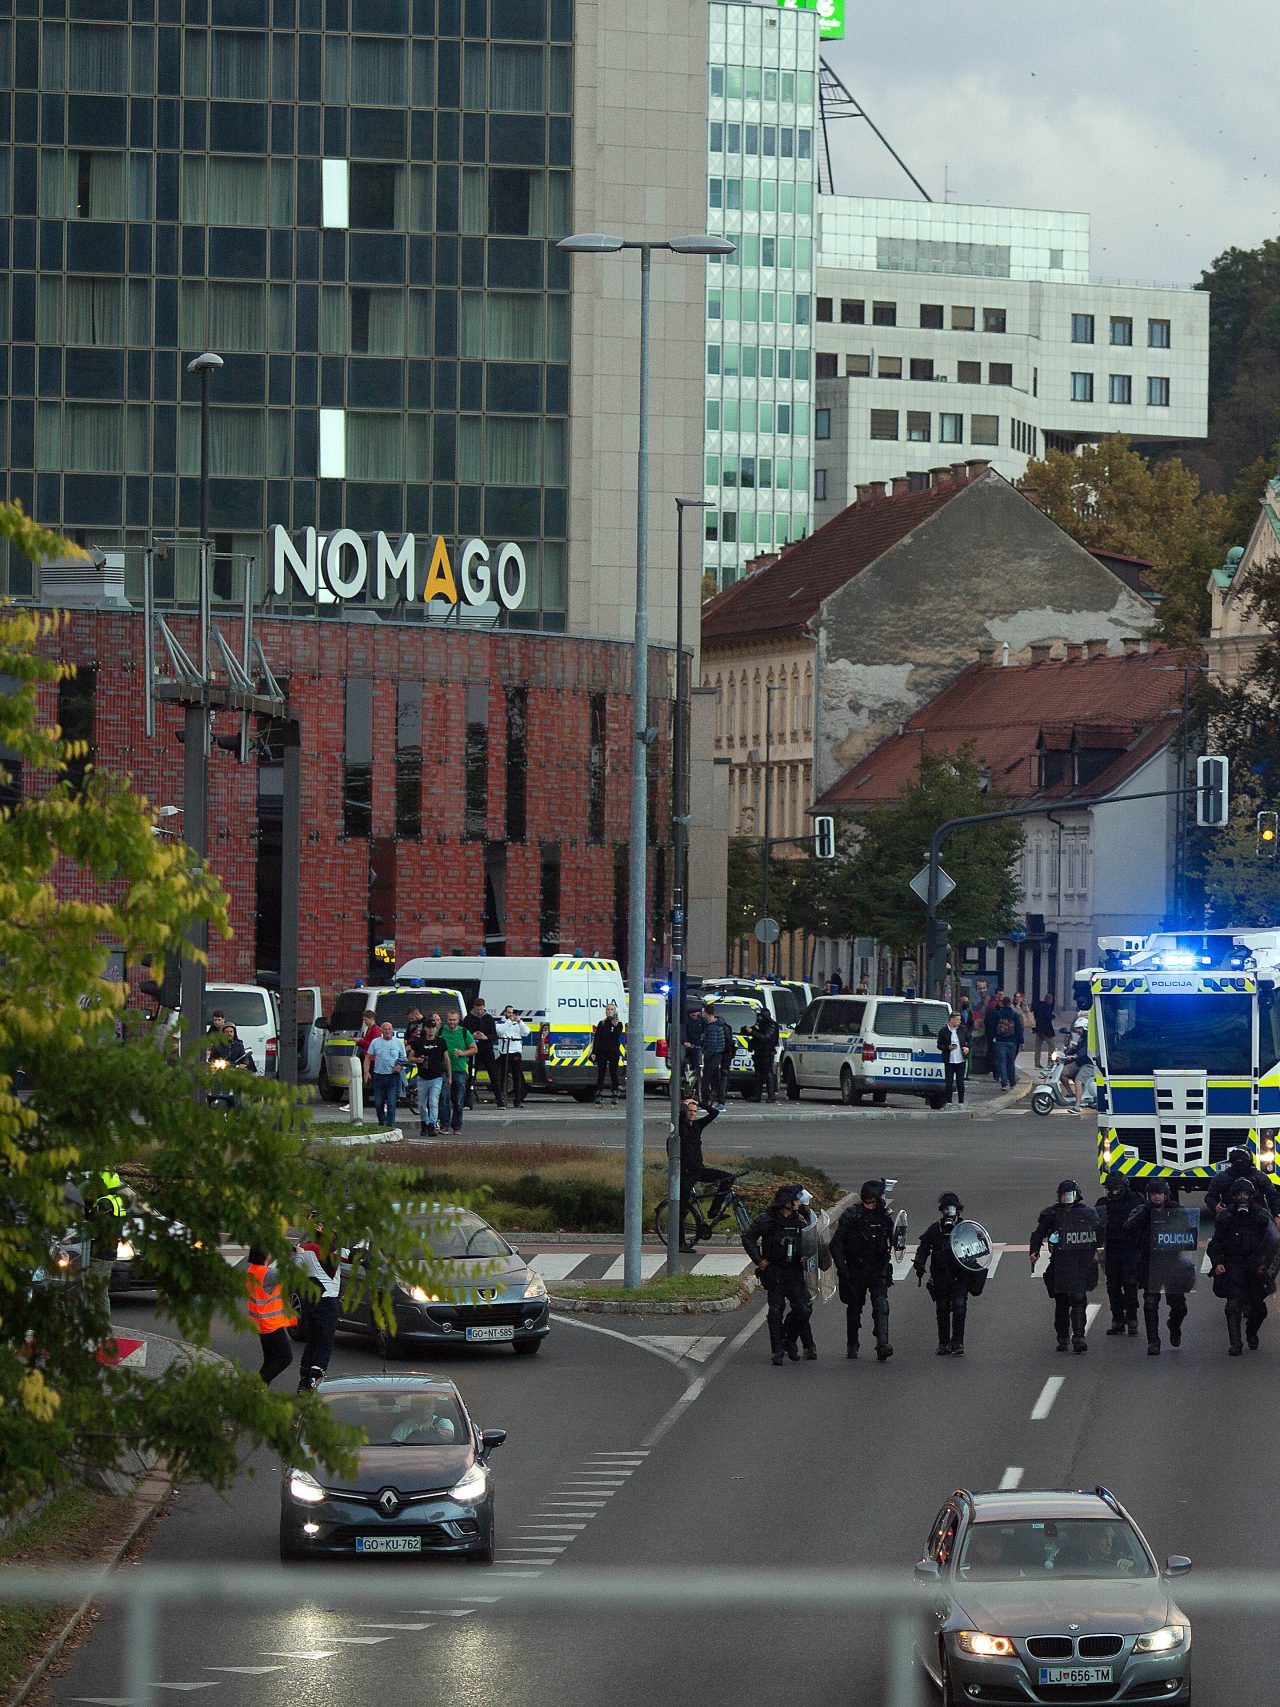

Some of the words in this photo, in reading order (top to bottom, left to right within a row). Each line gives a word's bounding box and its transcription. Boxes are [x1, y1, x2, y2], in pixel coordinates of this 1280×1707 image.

[270, 524, 526, 609] NOMAGO
[883, 1066, 943, 1077] POLICIJA
[1066, 1231, 1097, 1244] POLICIJA
[1158, 1233, 1194, 1244] POLICIJA
[364, 1540, 379, 1550] GO
[385, 1539, 419, 1549] KU-762
[1049, 1671, 1062, 1682] LJ
[1071, 1669, 1110, 1682] 656-TM
